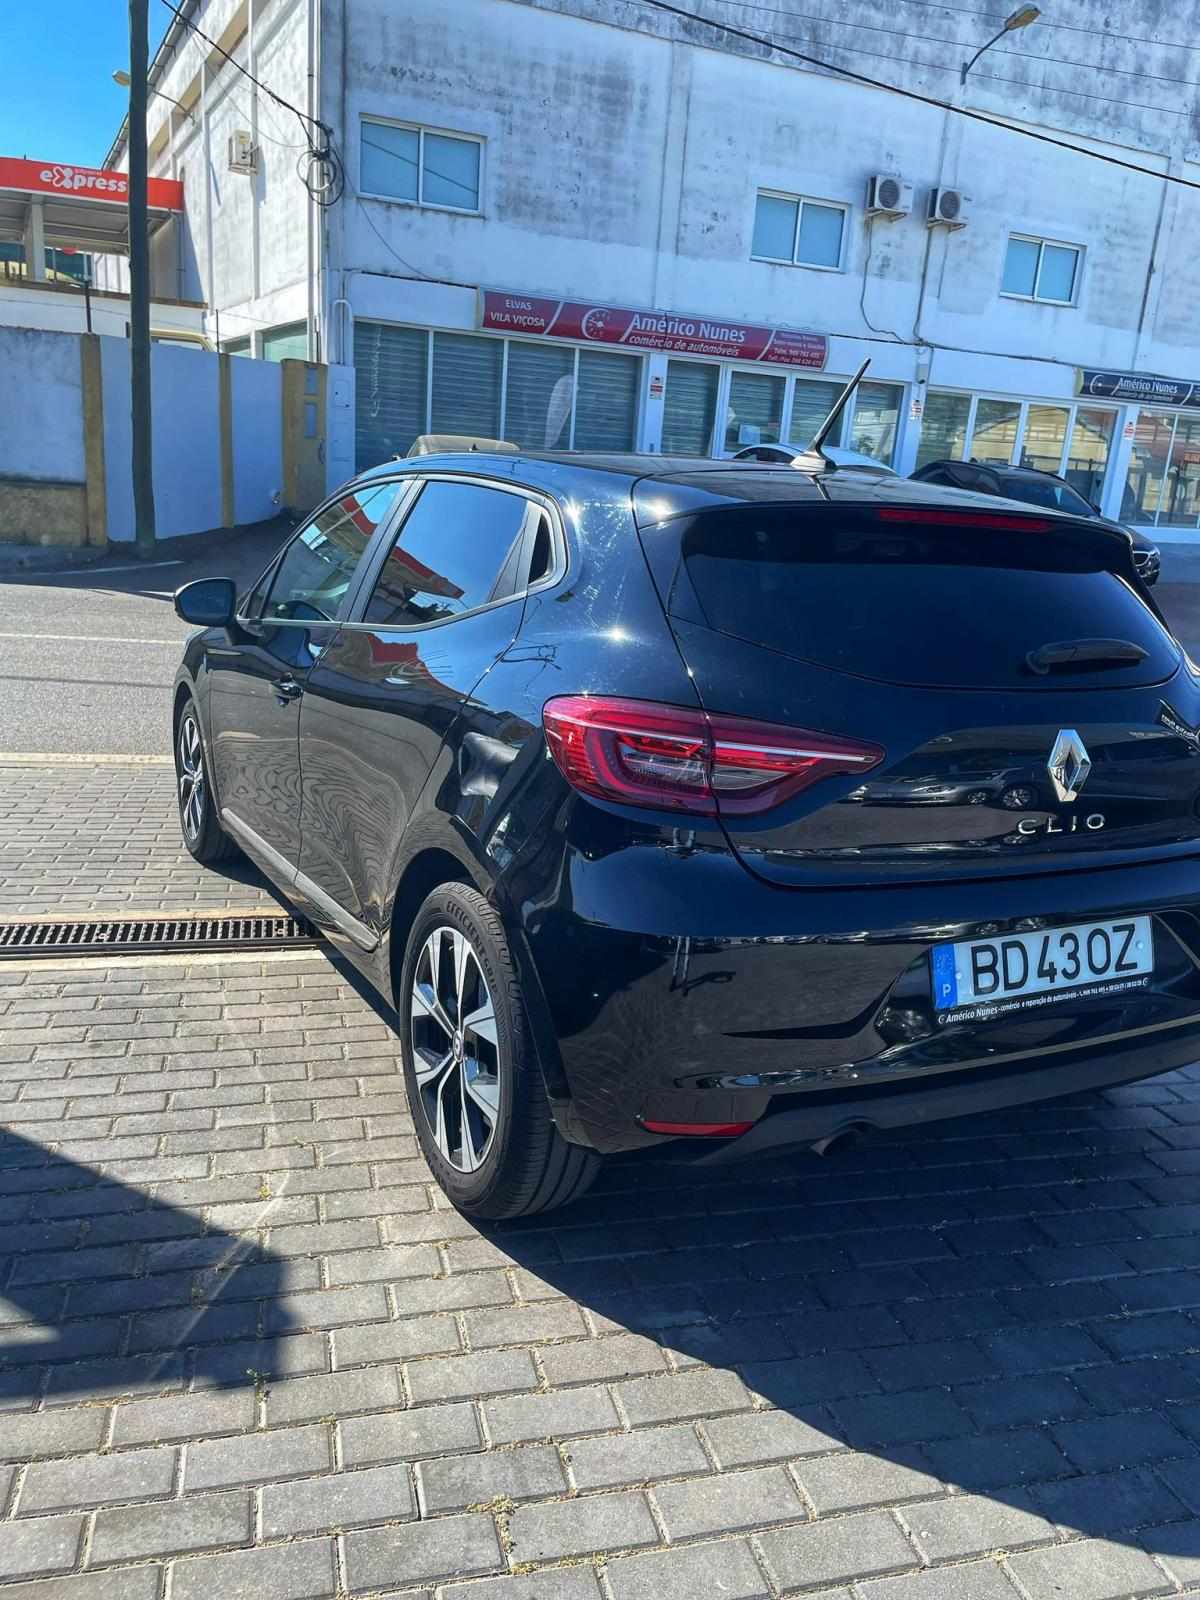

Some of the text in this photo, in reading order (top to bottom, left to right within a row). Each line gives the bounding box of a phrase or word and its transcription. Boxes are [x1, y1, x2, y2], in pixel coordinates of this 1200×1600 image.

[505, 300, 532, 310] ELVAS
[490, 312, 545, 327] VILA VIÇOSA
[631, 313, 746, 343] Américo Nunes
[628, 333, 740, 357] comércio de automóveis
[1117, 377, 1151, 390] Américo
[1152, 381, 1178, 394] Nunes
[1017, 813, 1105, 835] CLIO
[942, 983, 951, 997] P
[945, 1009, 975, 1024] Américo
